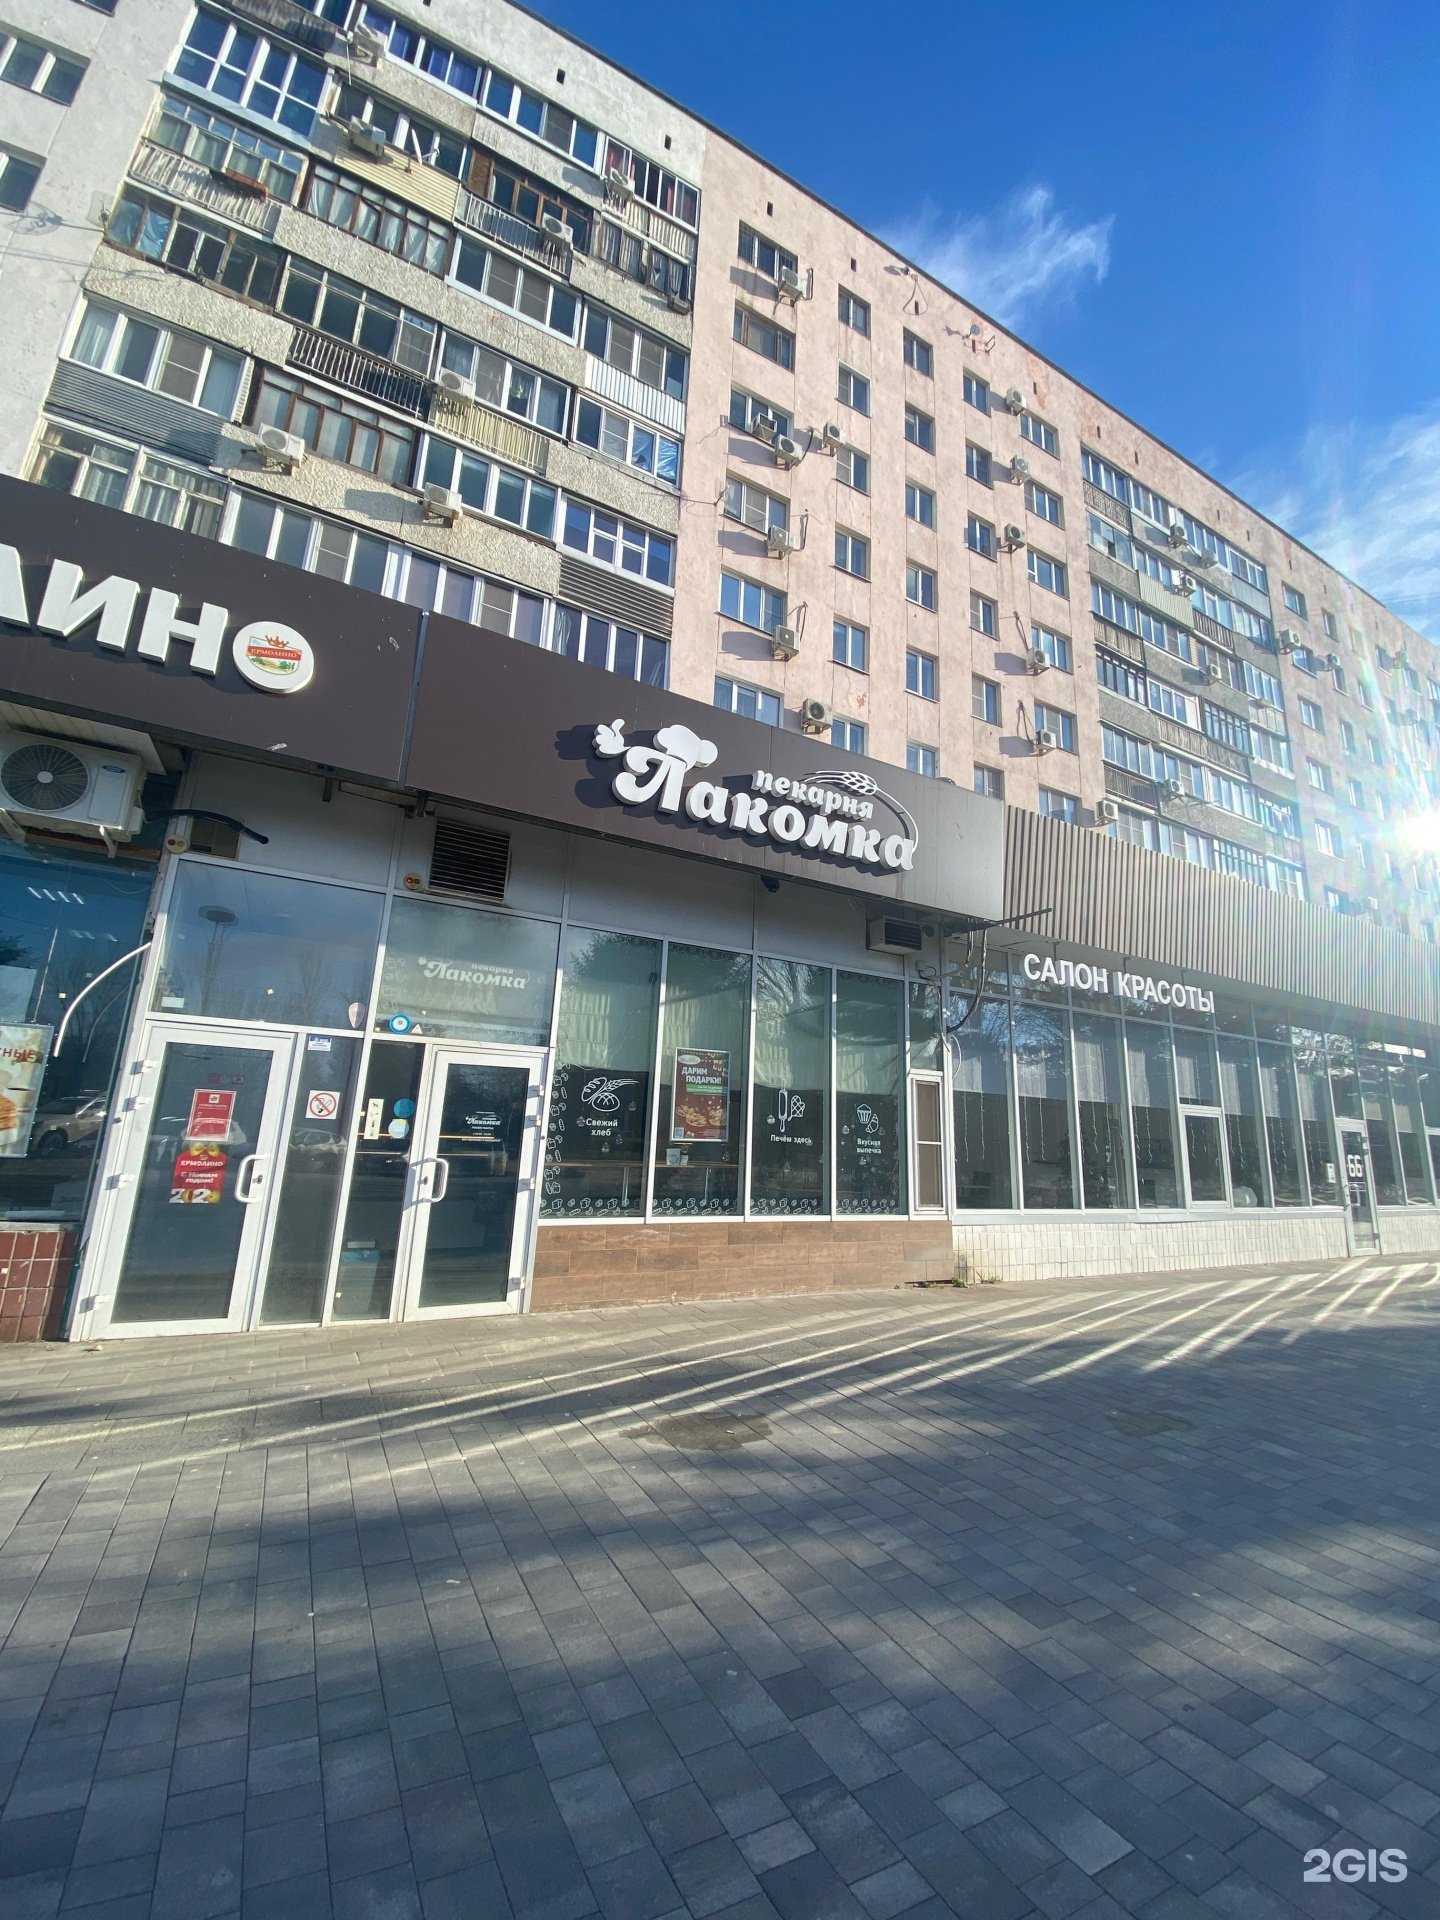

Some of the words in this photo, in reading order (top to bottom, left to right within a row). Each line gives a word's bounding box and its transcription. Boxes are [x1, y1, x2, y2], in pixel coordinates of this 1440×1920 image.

[611, 744, 914, 871] Лакомка
[752, 769, 875, 820] пекарня
[423, 961, 527, 989] Лакомка
[1023, 953, 1109, 994] САЛОН
[1113, 970, 1215, 1014] КРАСОТЫ
[681, 1066, 708, 1075] ДАРИМ
[585, 1118, 618, 1127] Свежий
[591, 1128, 612, 1136] хлеб
